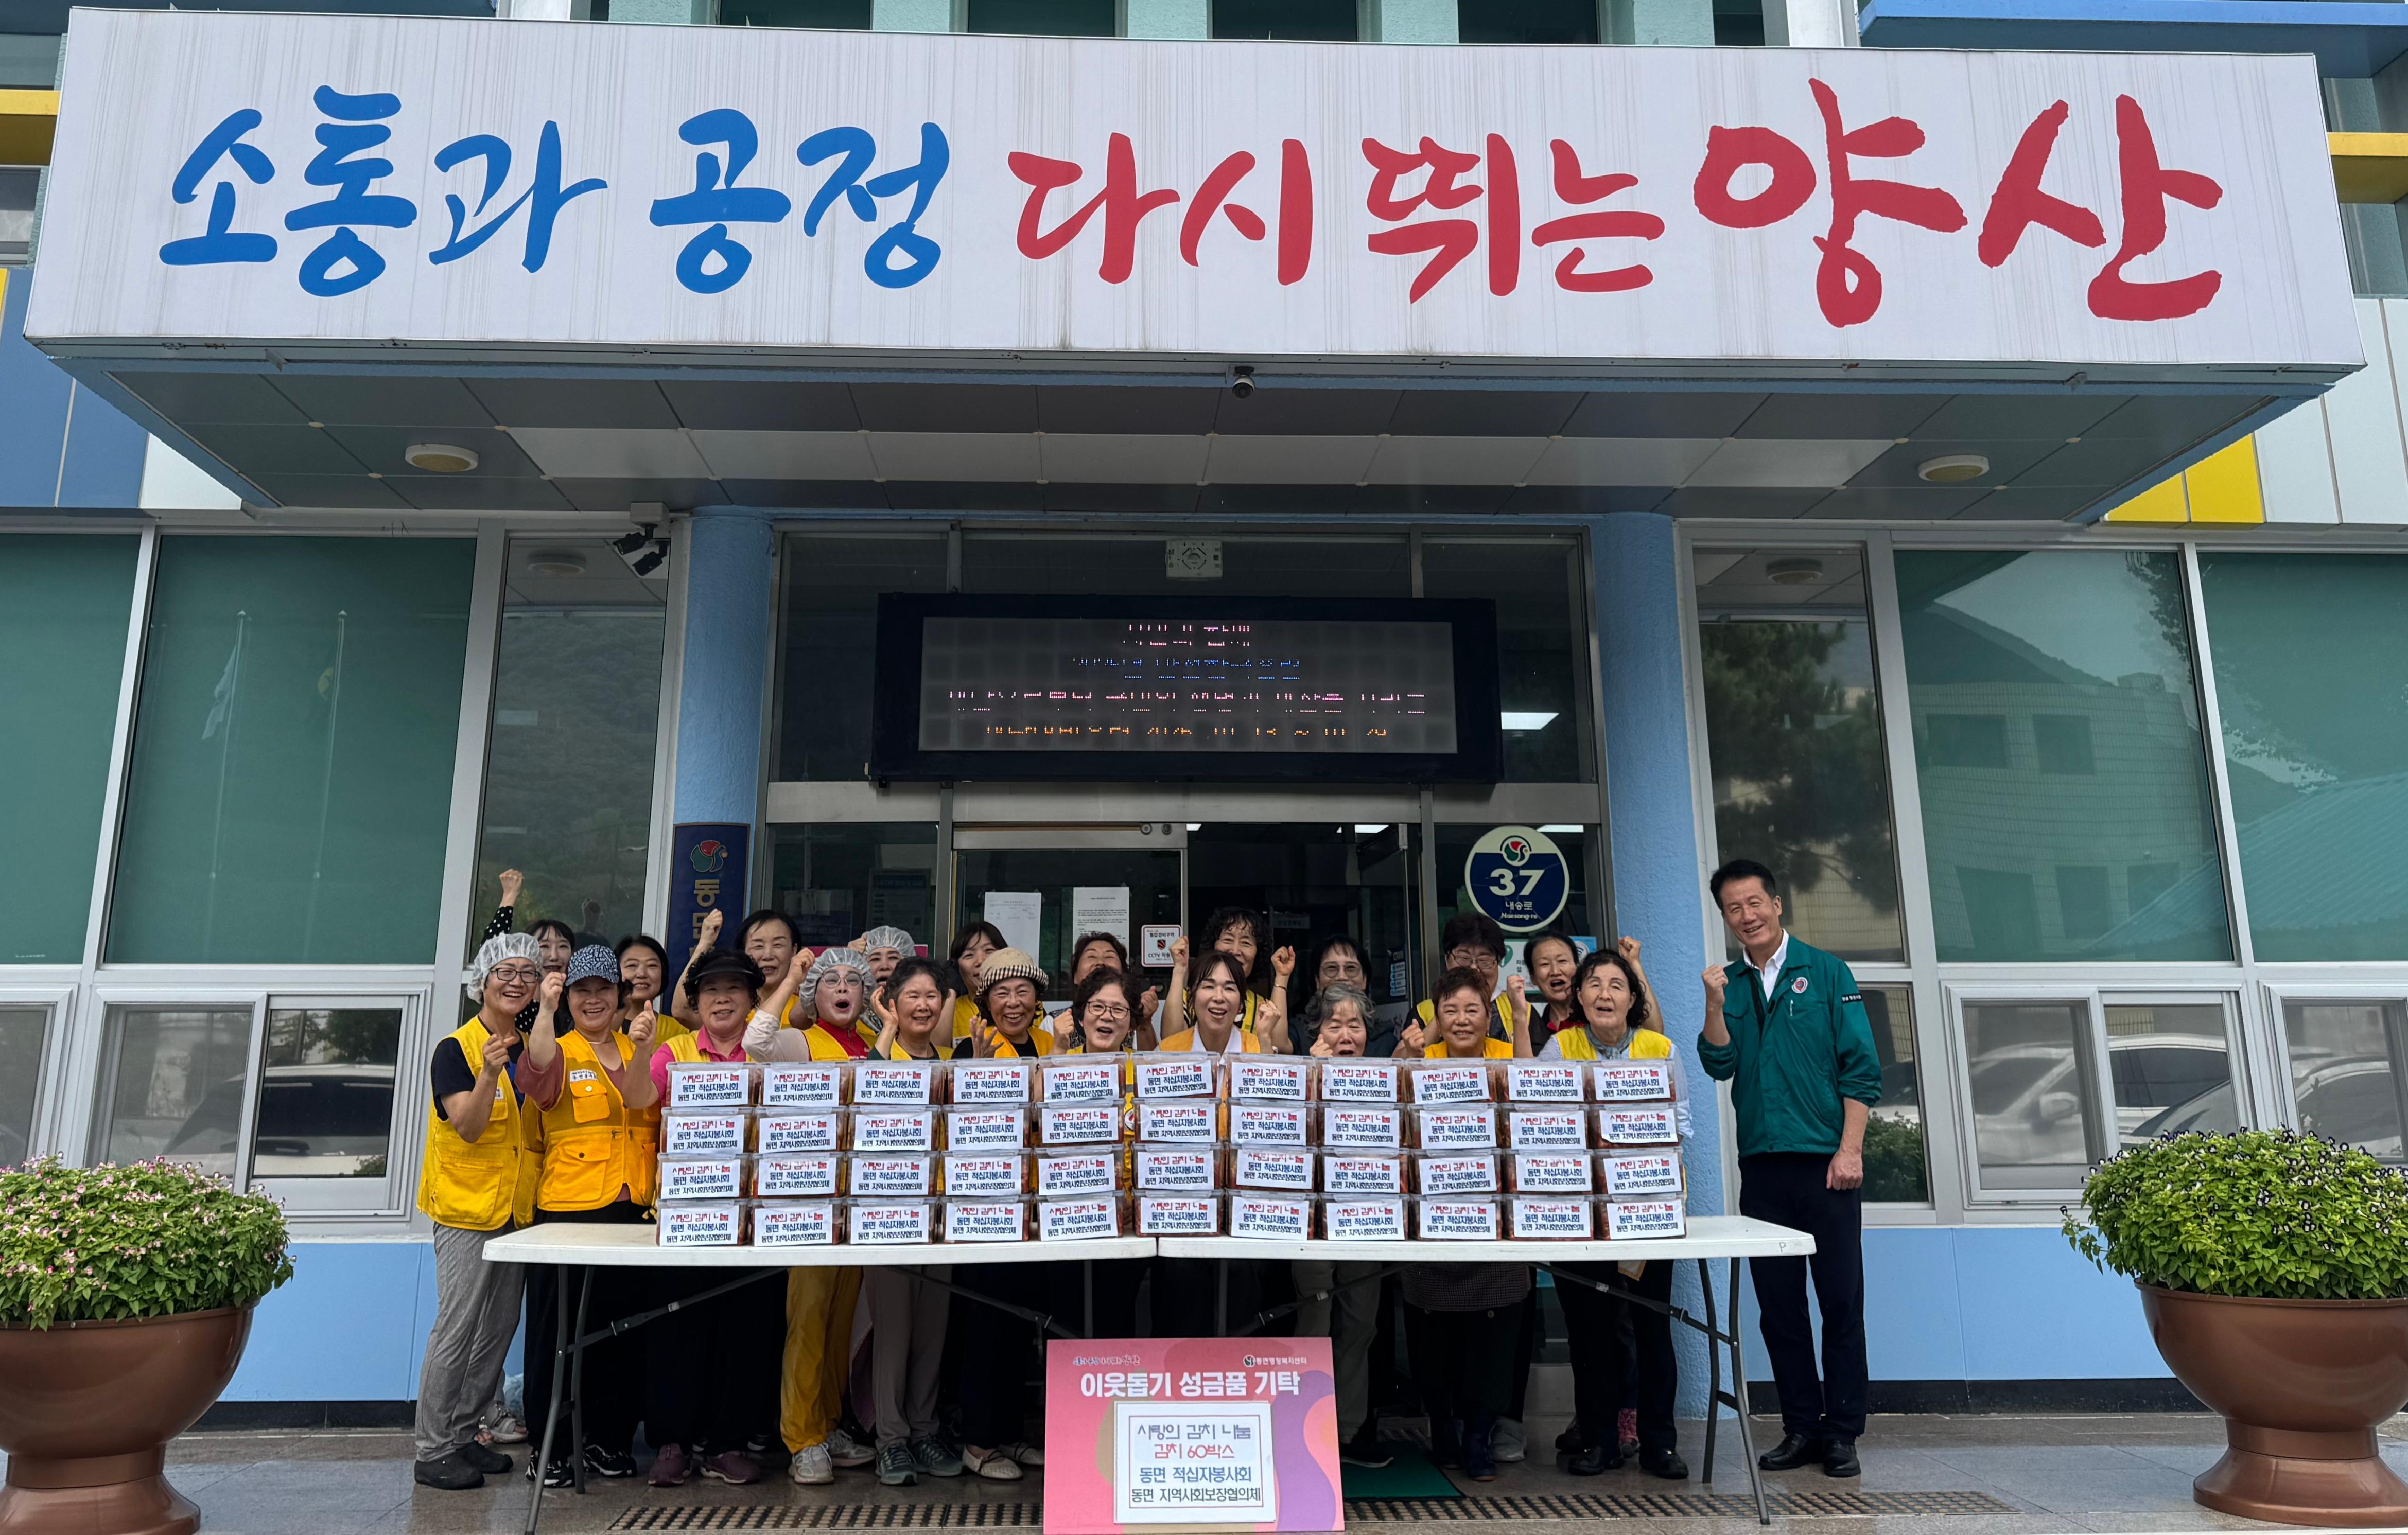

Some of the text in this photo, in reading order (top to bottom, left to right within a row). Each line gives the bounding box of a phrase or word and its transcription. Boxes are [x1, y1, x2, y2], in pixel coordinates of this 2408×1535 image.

[160, 80, 2221, 327] 소통과 공정 다시 뛰는 양산
[1489, 868, 1545, 896] 37
[1506, 901, 1533, 910] 내송로
[1171, 1066, 1184, 1074] 김치
[866, 1080, 920, 1089] 동면 적십자봉사회
[1148, 1073, 1202, 1086] 동면 적십자봉사회
[1349, 1079, 1387, 1088] 적십자봉사회
[1535, 1079, 1573, 1087] 적십자봉사회
[699, 1083, 738, 1092] 적십자봉사회
[702, 1121, 717, 1129] 김치
[1151, 1118, 1206, 1128] 동면 적십자봉사회
[1336, 1123, 1390, 1133] 동면 적십자봉사회
[678, 1130, 734, 1140] 동면 적십자봉사회
[866, 1128, 921, 1138] 동면 적십자봉사회
[1522, 1127, 1576, 1135] 동면 적십자봉사회
[980, 1162, 994, 1170] 김치
[1149, 1166, 1203, 1175] 동면 적십자봉사회
[1454, 1162, 1468, 1171] 김치
[972, 1171, 1011, 1180] 적십자봉사회
[1431, 1171, 1486, 1183] 동면 적십자봉사회
[1152, 1212, 1207, 1221] 동면 적십자봉사회
[1619, 1213, 1673, 1224] 동면 적십자봉사회
[671, 1223, 727, 1233] 동면 적십자봉사회
[863, 1220, 918, 1230] 동면 적십자봉사회
[1779, 1242, 1786, 1252] P
[1081, 1371, 1300, 1397] 이웃돕기 성금품 기탁
[1138, 1424, 1251, 1440] 사랑의 김치 나눔
[1155, 1443, 1234, 1459] 김치 60박스
[1140, 1466, 1251, 1483] 동면 적십자봉사회
[1131, 1487, 1261, 1503] 동면 지역사회보장협의체
